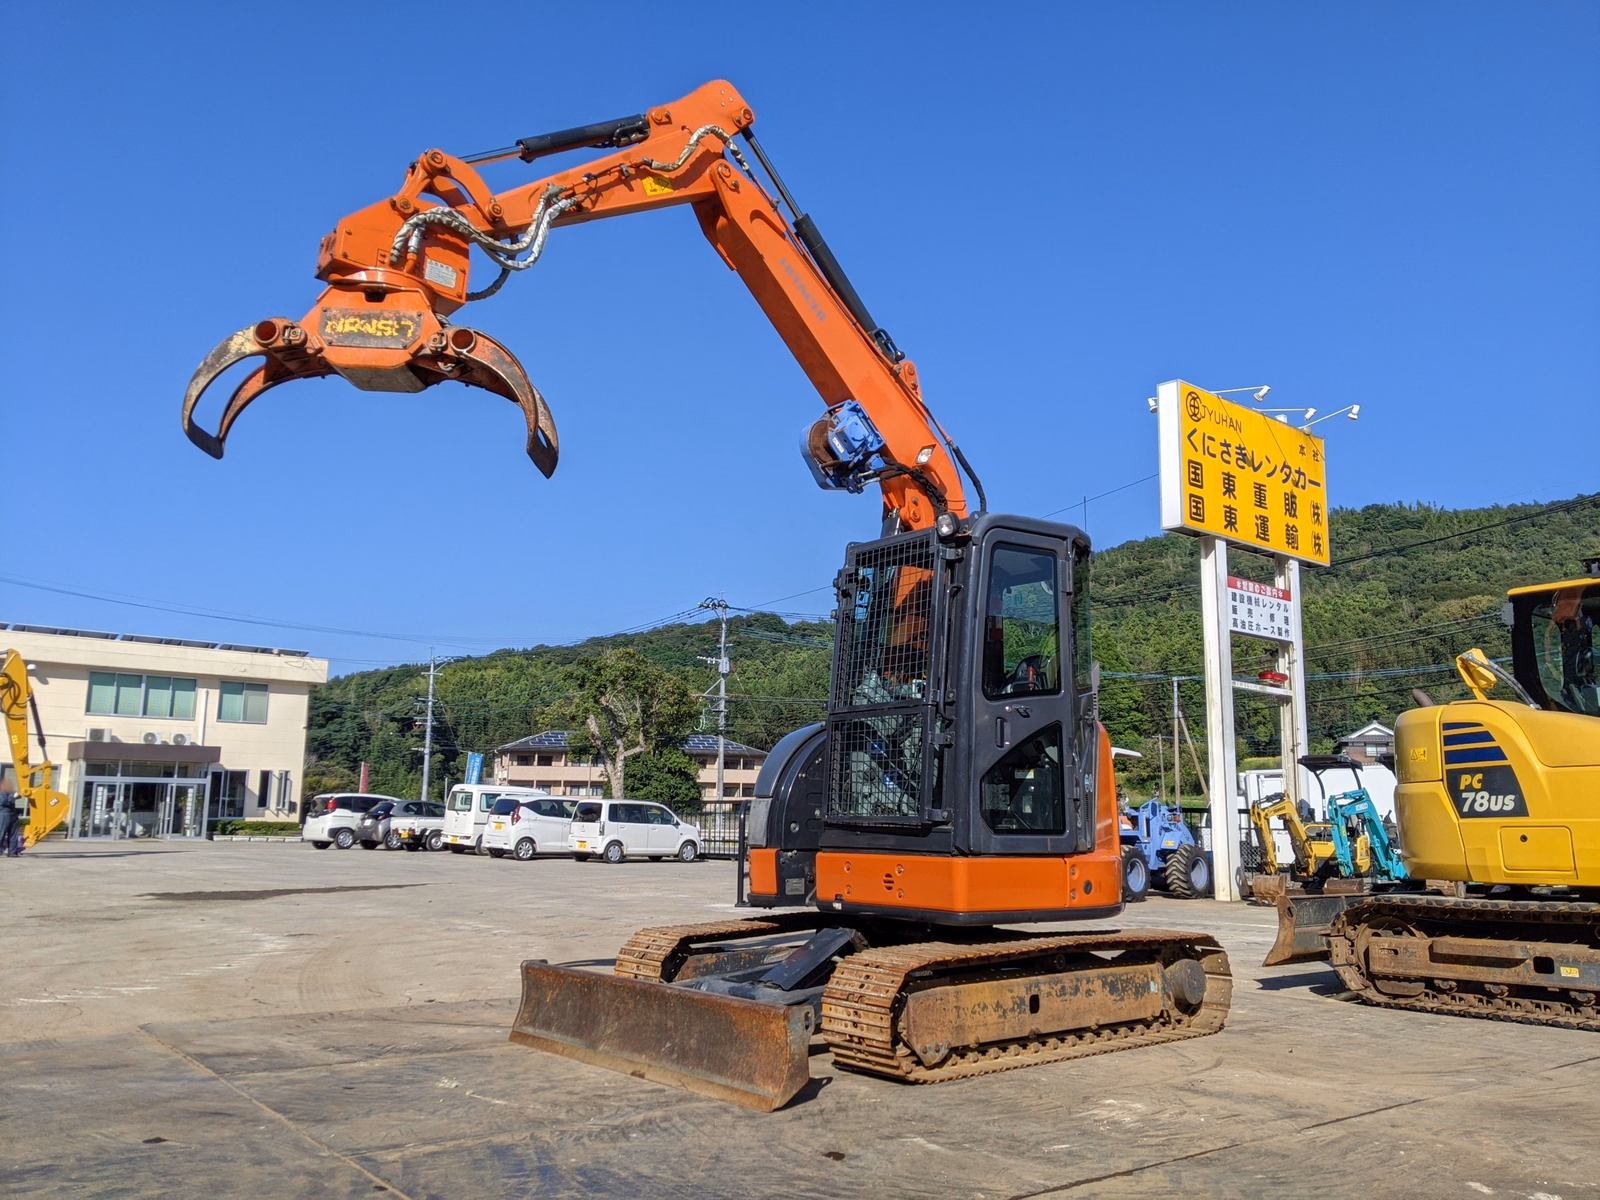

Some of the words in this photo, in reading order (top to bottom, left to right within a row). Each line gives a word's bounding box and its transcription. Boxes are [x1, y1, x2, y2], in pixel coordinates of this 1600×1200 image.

[1187, 428, 1320, 490] くにさきレンタカー
[1298, 444, 1320, 463] 本社
[1460, 773, 1483, 790] PC
[1462, 791, 1515, 813] 78US
